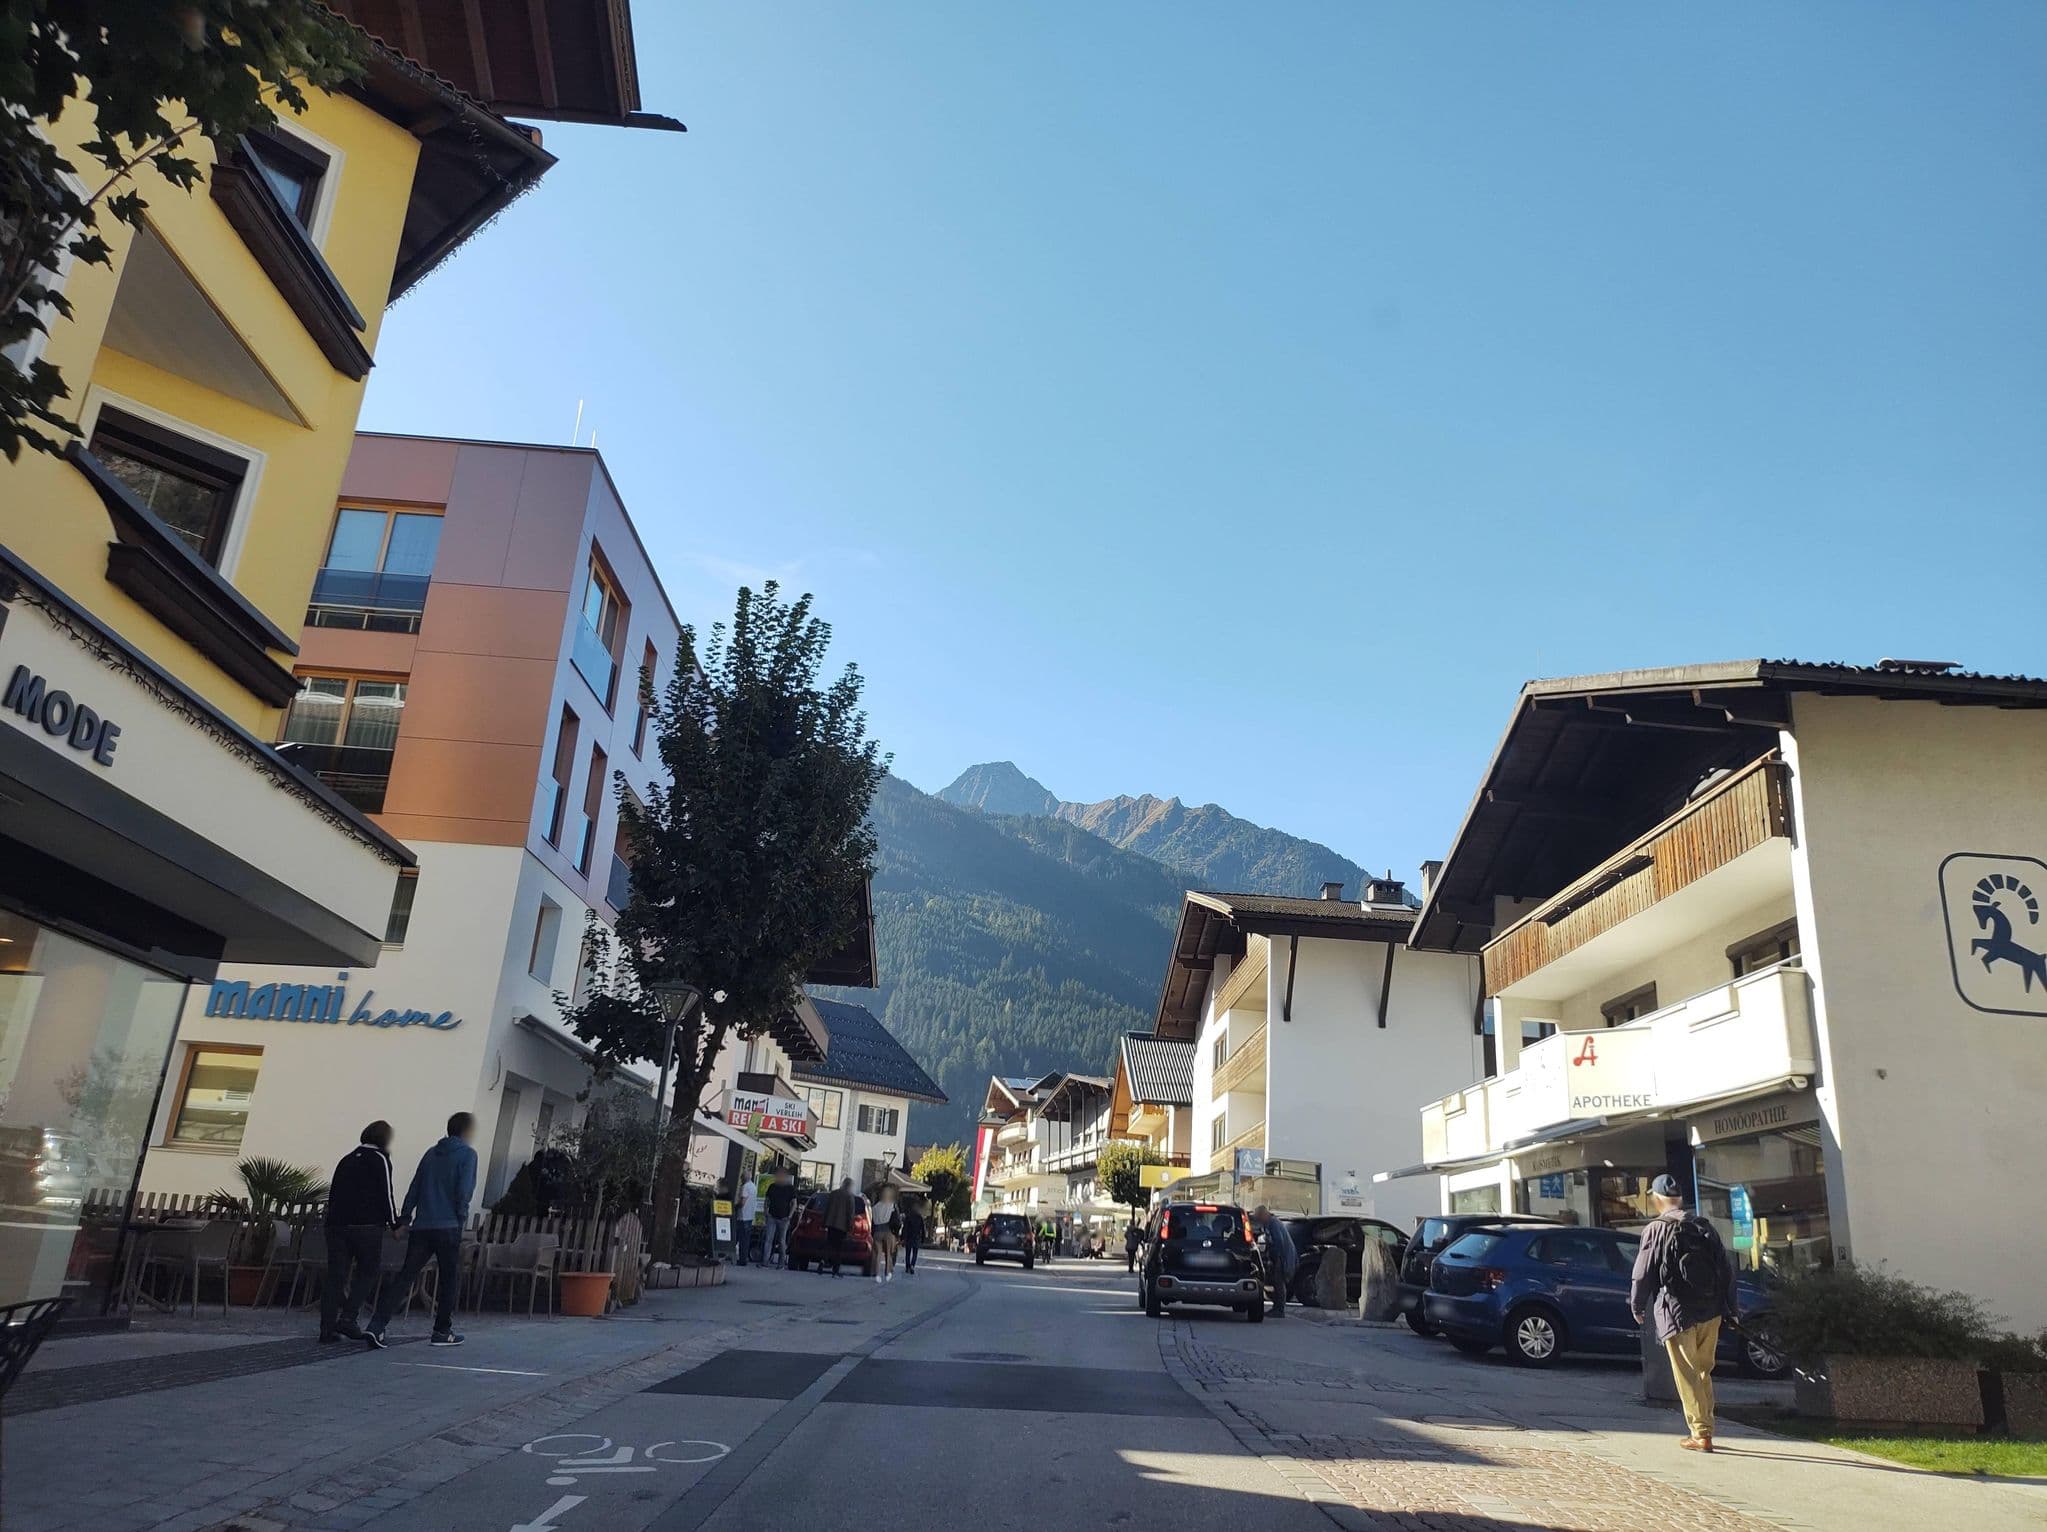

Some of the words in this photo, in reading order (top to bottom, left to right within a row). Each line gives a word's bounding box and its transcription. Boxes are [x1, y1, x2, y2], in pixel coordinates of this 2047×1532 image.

[2, 664, 122, 768] MODE
[205, 971, 349, 1024] manni
[347, 990, 462, 1030] home
[785, 1102, 796, 1110] SKI
[1572, 1094, 1652, 1109] APOTHEKE
[775, 1109, 803, 1119] VERLEIH
[1713, 1104, 1789, 1135] HOMÖOPATHIE
[768, 1118, 777, 1130] A
[781, 1119, 801, 1132] SKI
